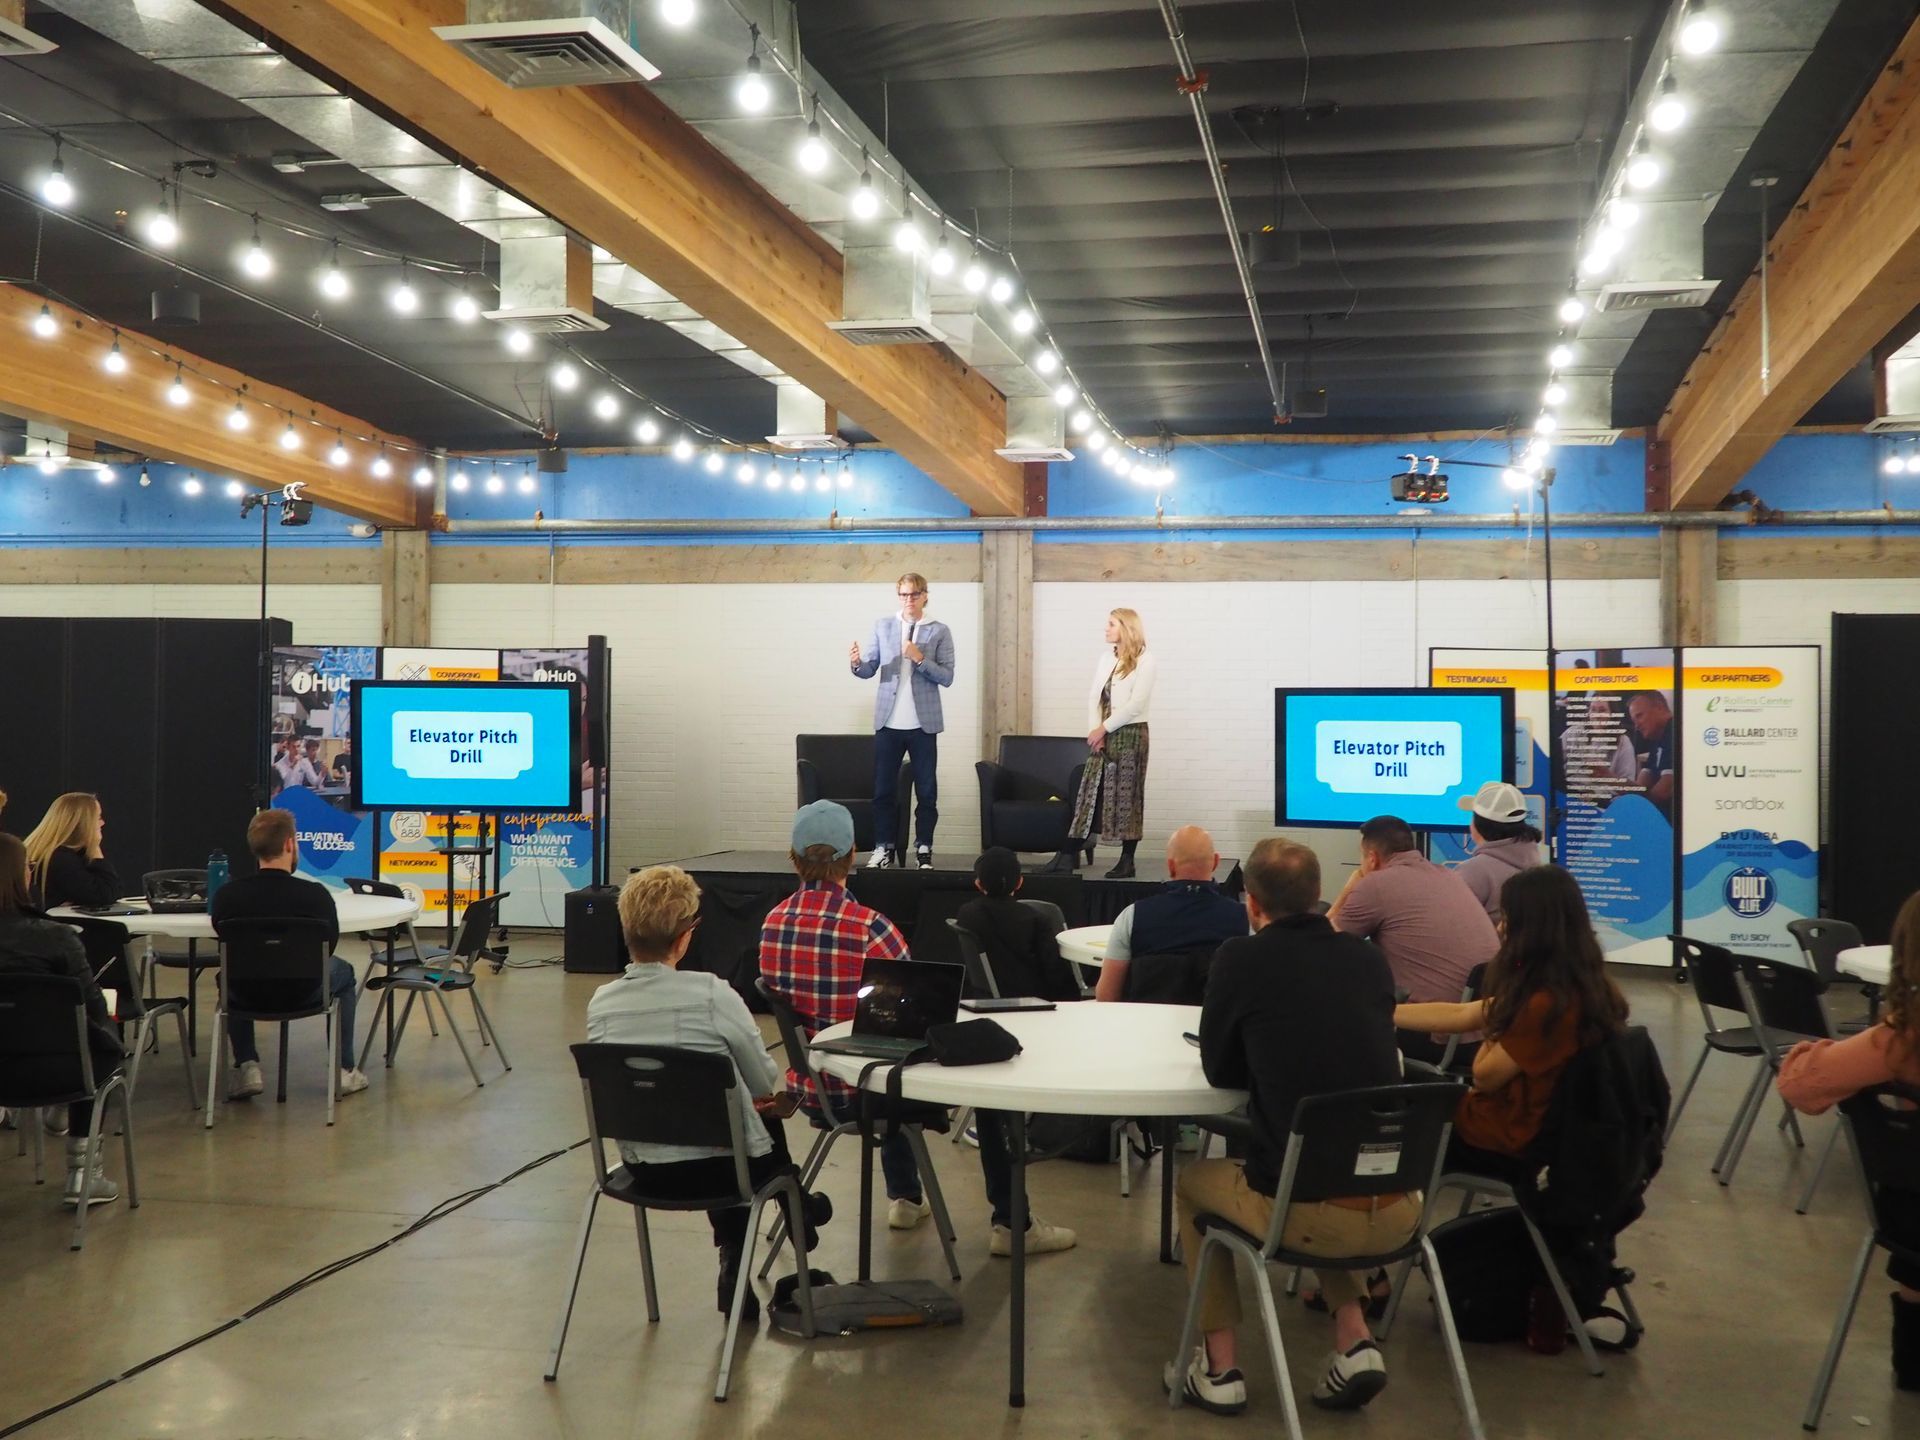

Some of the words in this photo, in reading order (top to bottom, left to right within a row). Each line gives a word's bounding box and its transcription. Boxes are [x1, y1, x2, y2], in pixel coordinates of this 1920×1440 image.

[1445, 675, 1507, 684] TESTIMONIALS
[1574, 675, 1639, 684] CONTRIBUTORS
[1701, 674, 1721, 683] OUR
[1722, 674, 1771, 683] PARTNERS
[410, 729, 474, 743] Elevator
[479, 729, 518, 744] Pitch
[1724, 728, 1765, 738] BALLARD
[1767, 728, 1798, 738] CENTER
[1334, 740, 1399, 755] Elevator
[1405, 741, 1445, 756] Pitch
[450, 749, 482, 763] Drill
[1375, 762, 1408, 777] Drill
[1706, 765, 1746, 777] UVU
[1715, 797, 1785, 811] sandbox
[296, 832, 344, 842] ELEVATING
[510, 833, 538, 844] WHO
[539, 834, 573, 845] WANT
[1721, 832, 1750, 840] BYU
[1752, 832, 1779, 840] MBA
[313, 841, 355, 850] SUCCESS
[510, 845, 526, 856] TO
[527, 845, 557, 856] MAKE
[560, 846, 568, 856] A
[1732, 876, 1767, 898] BUILT
[1730, 933, 1749, 941] BYU
